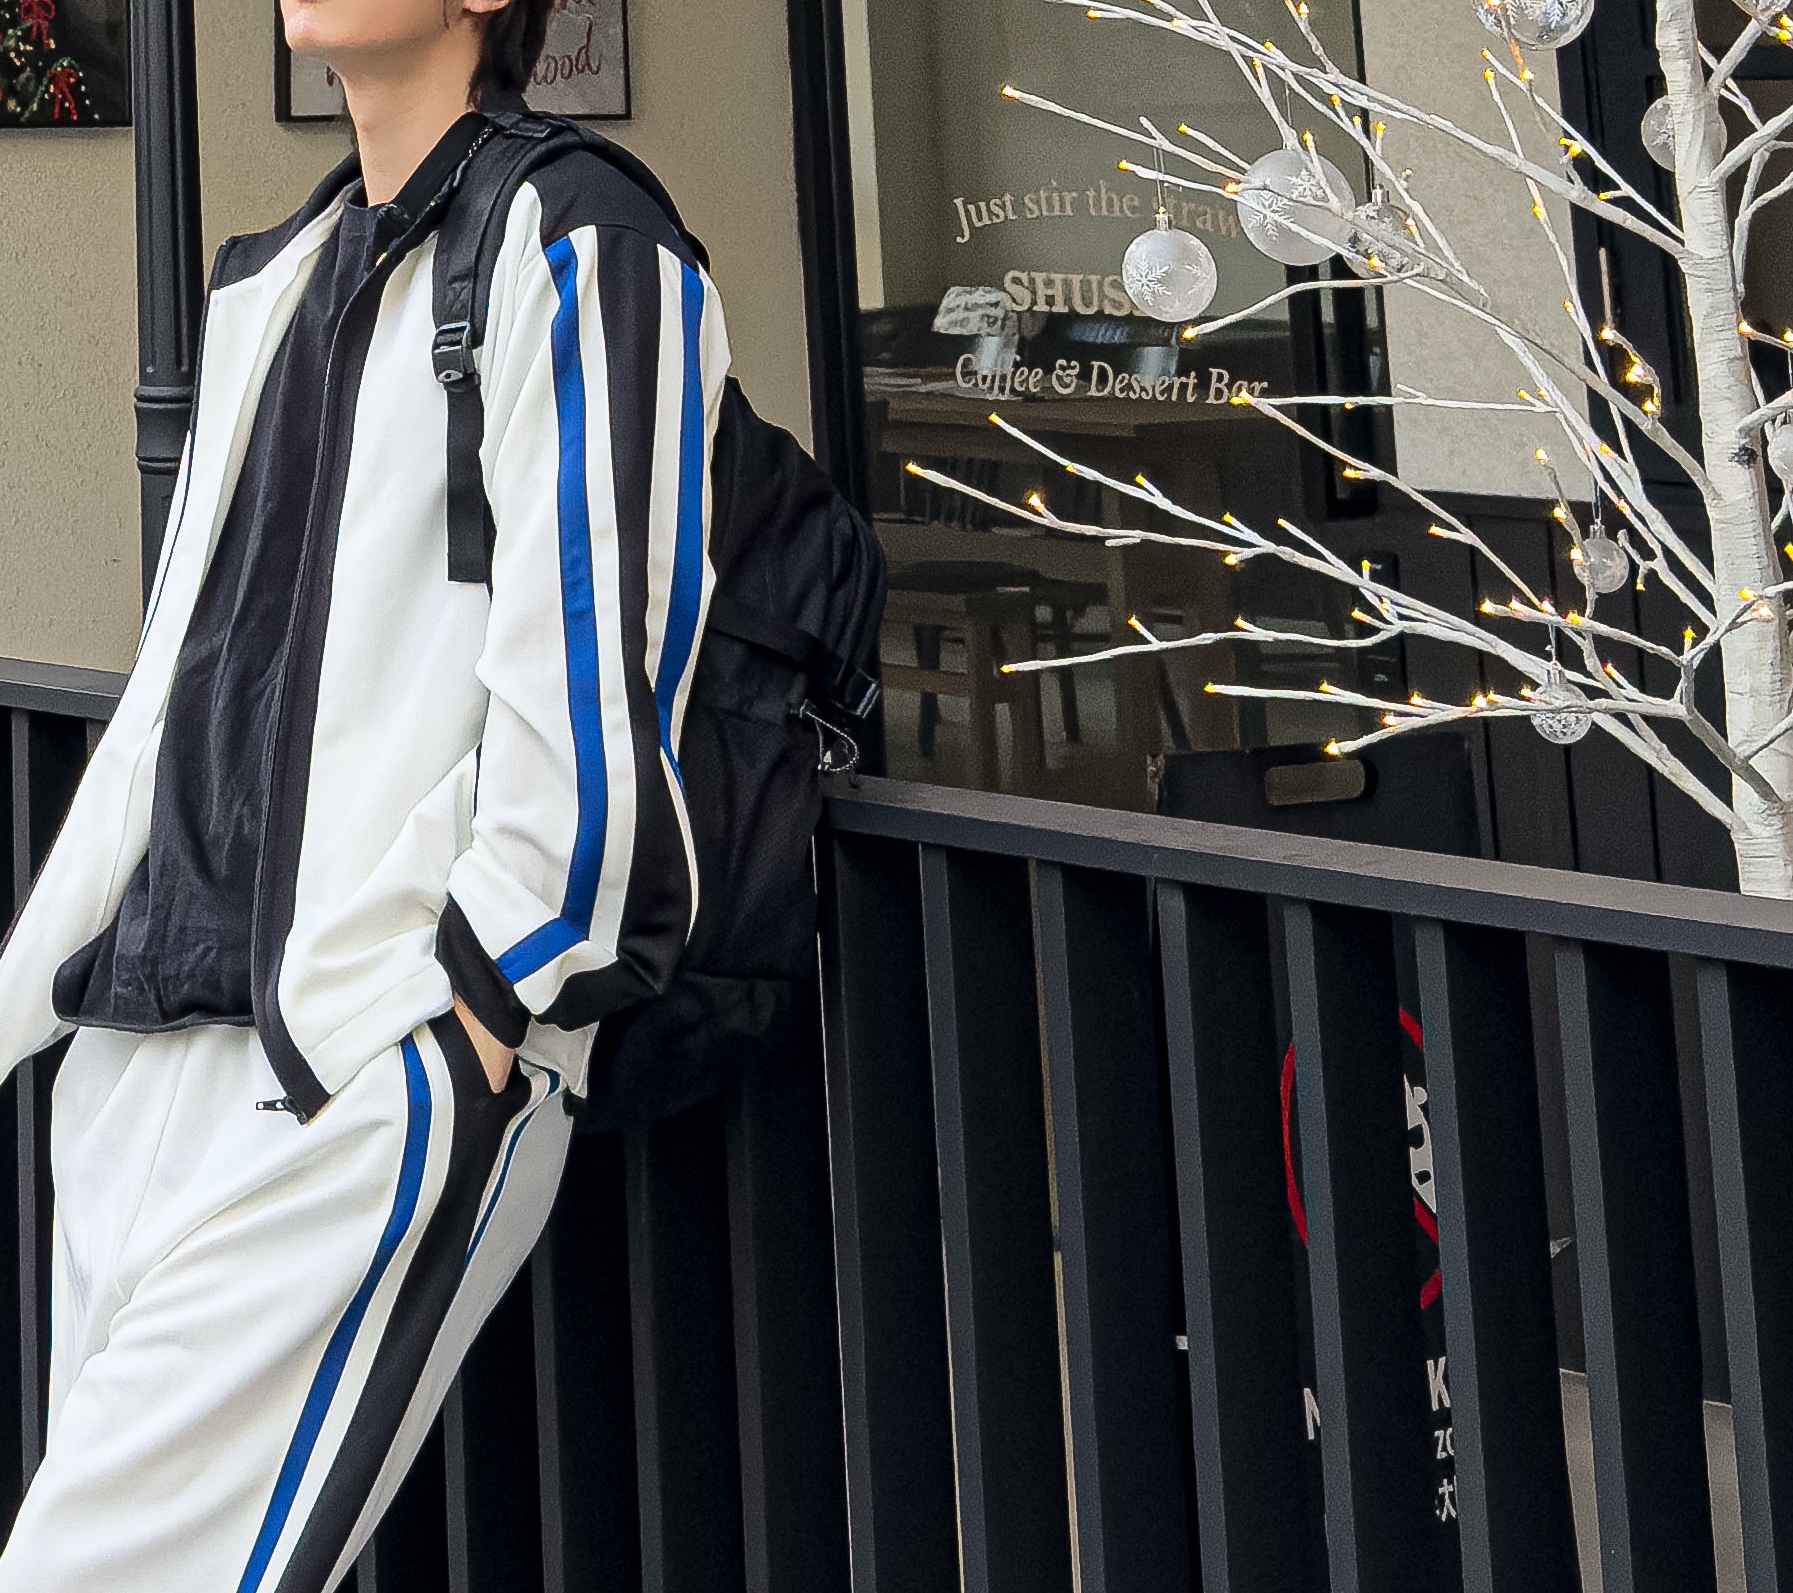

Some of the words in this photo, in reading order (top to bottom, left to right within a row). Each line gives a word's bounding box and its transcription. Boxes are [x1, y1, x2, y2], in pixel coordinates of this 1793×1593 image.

[953, 192, 1018, 244] Just
[1023, 178, 1078, 220] stir
[1085, 179, 1140, 218] the
[955, 353, 1044, 400] Coffee
[1051, 358, 1080, 395] &
[1087, 360, 1197, 403] Dessert
[1205, 367, 1269, 405] Bar
